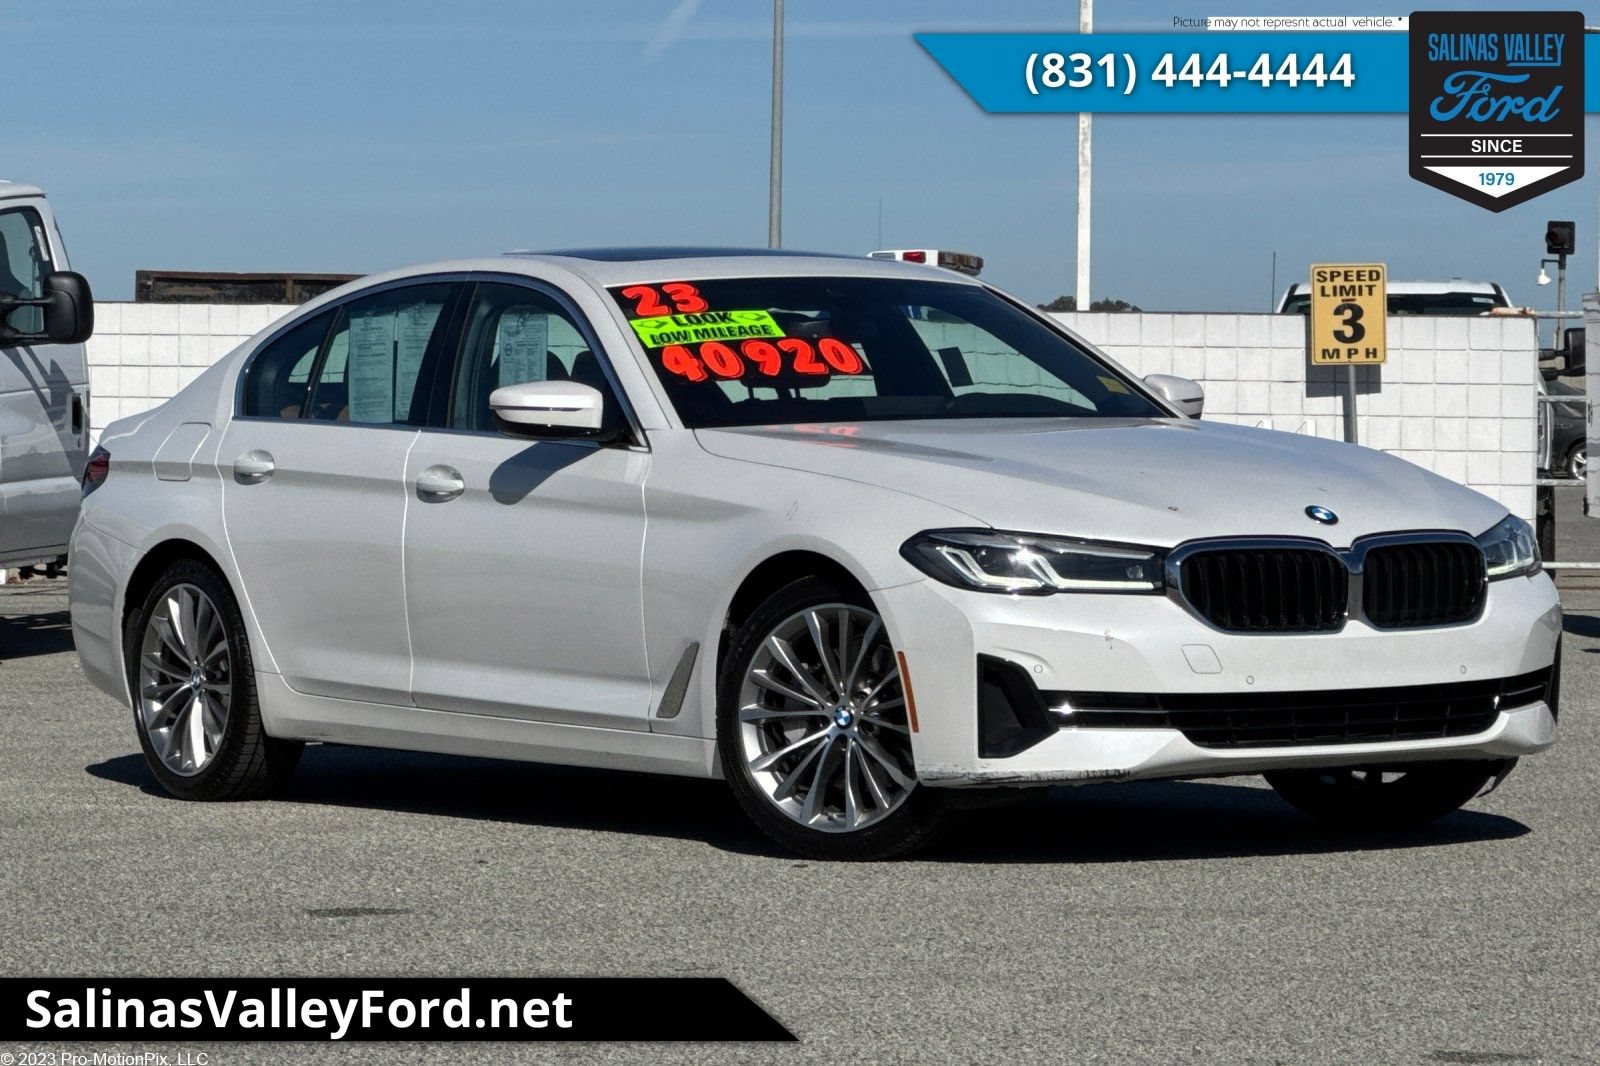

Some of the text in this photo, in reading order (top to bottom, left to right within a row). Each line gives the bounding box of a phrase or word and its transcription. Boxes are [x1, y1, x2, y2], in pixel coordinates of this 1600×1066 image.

[1316, 269, 1381, 283] SPEED
[621, 282, 708, 316] 23
[1320, 284, 1376, 297] LIMIT
[671, 312, 736, 327] LOOK
[1333, 303, 1365, 344] 3
[650, 324, 774, 345] LOW MILEAGE
[661, 337, 863, 382] 40920
